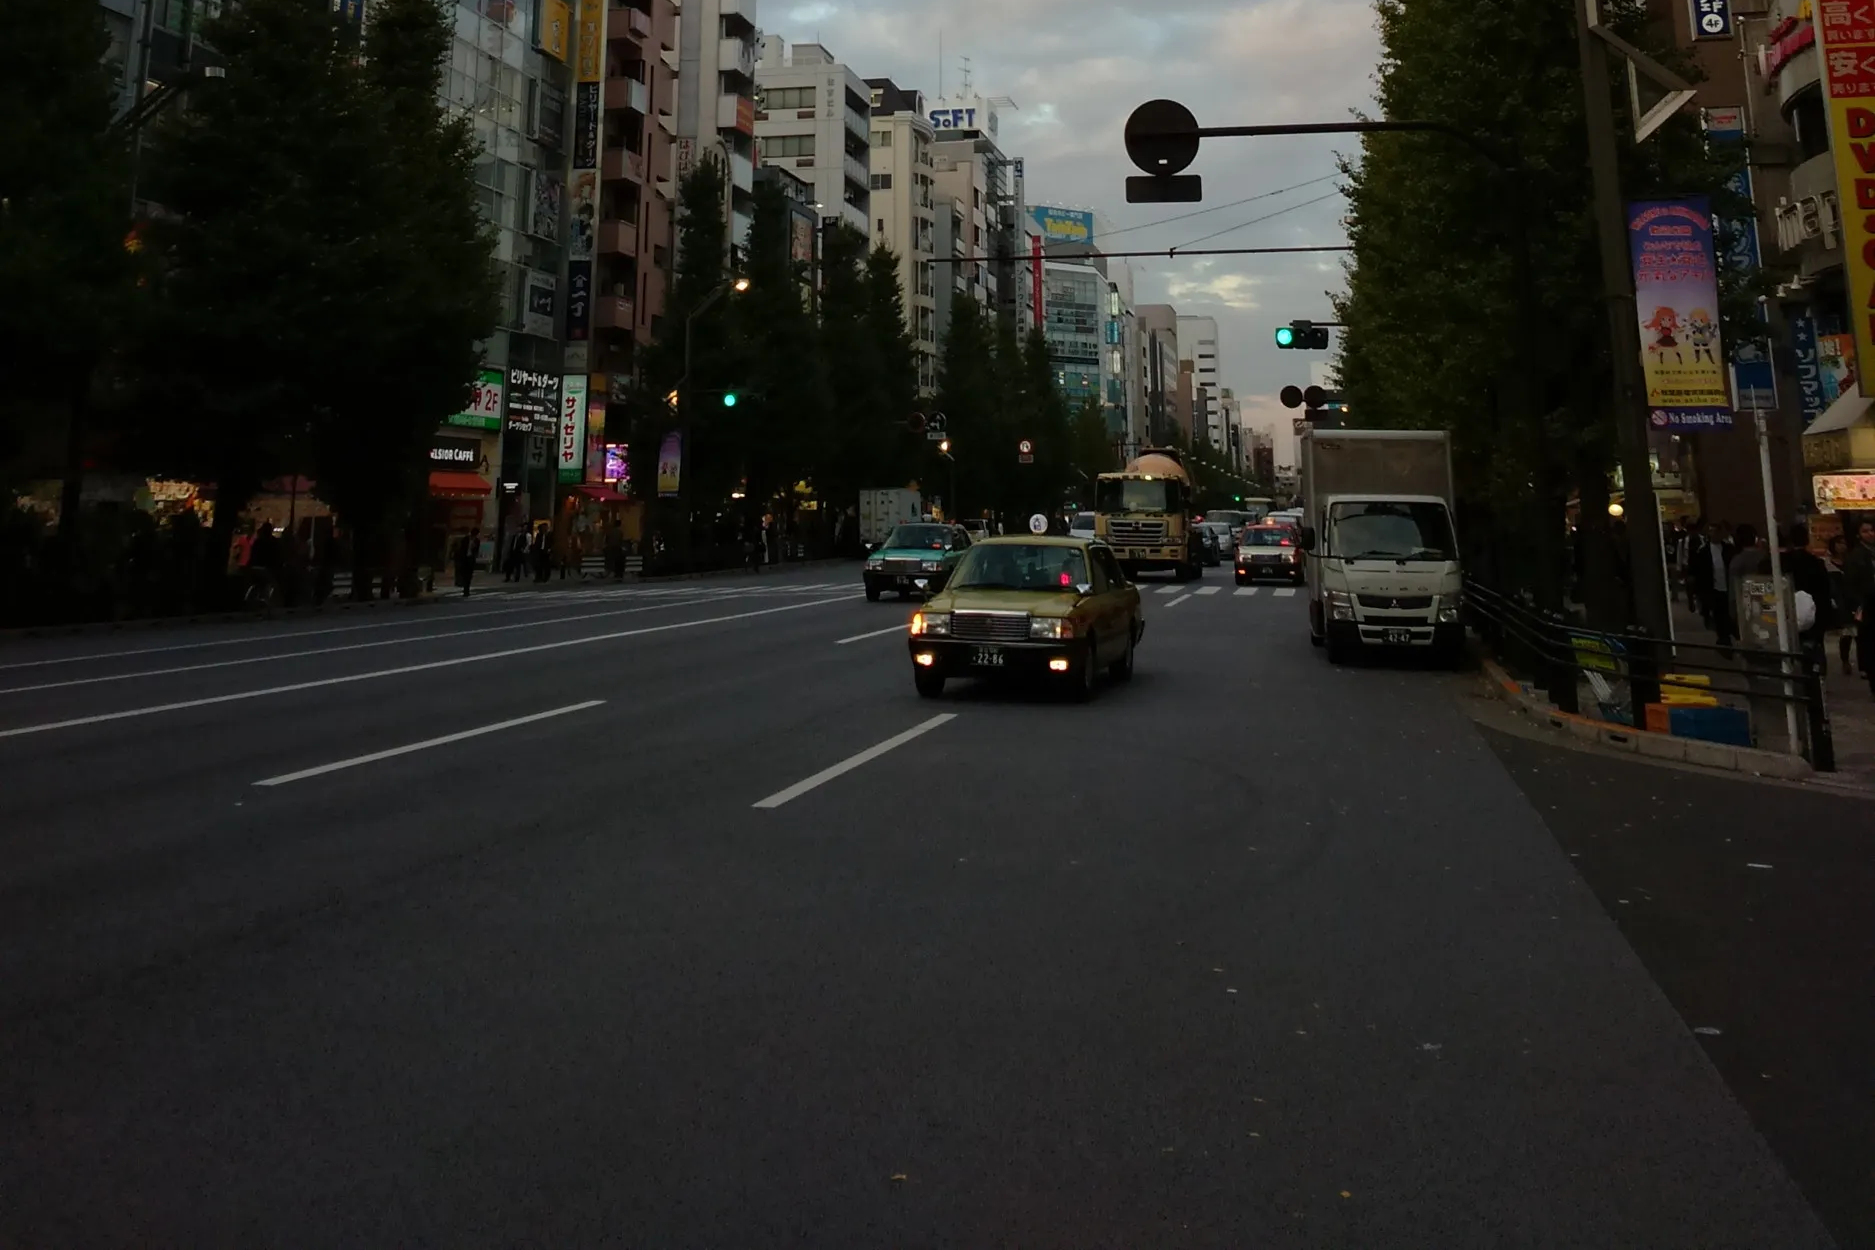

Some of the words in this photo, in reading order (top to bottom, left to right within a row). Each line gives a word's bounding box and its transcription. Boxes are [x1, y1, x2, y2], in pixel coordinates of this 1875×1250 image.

[1706, 18, 1720, 28] 4F
[1821, 0, 1873, 27] 高く
[1832, 82, 1875, 95] 売りま
[510, 368, 559, 391] ビリヤード&ダーツ
[1668, 411, 1680, 424] No
[1680, 411, 1714, 426] Smoking
[1716, 411, 1732, 424] Area
[562, 396, 577, 463] サイゼリヤ
